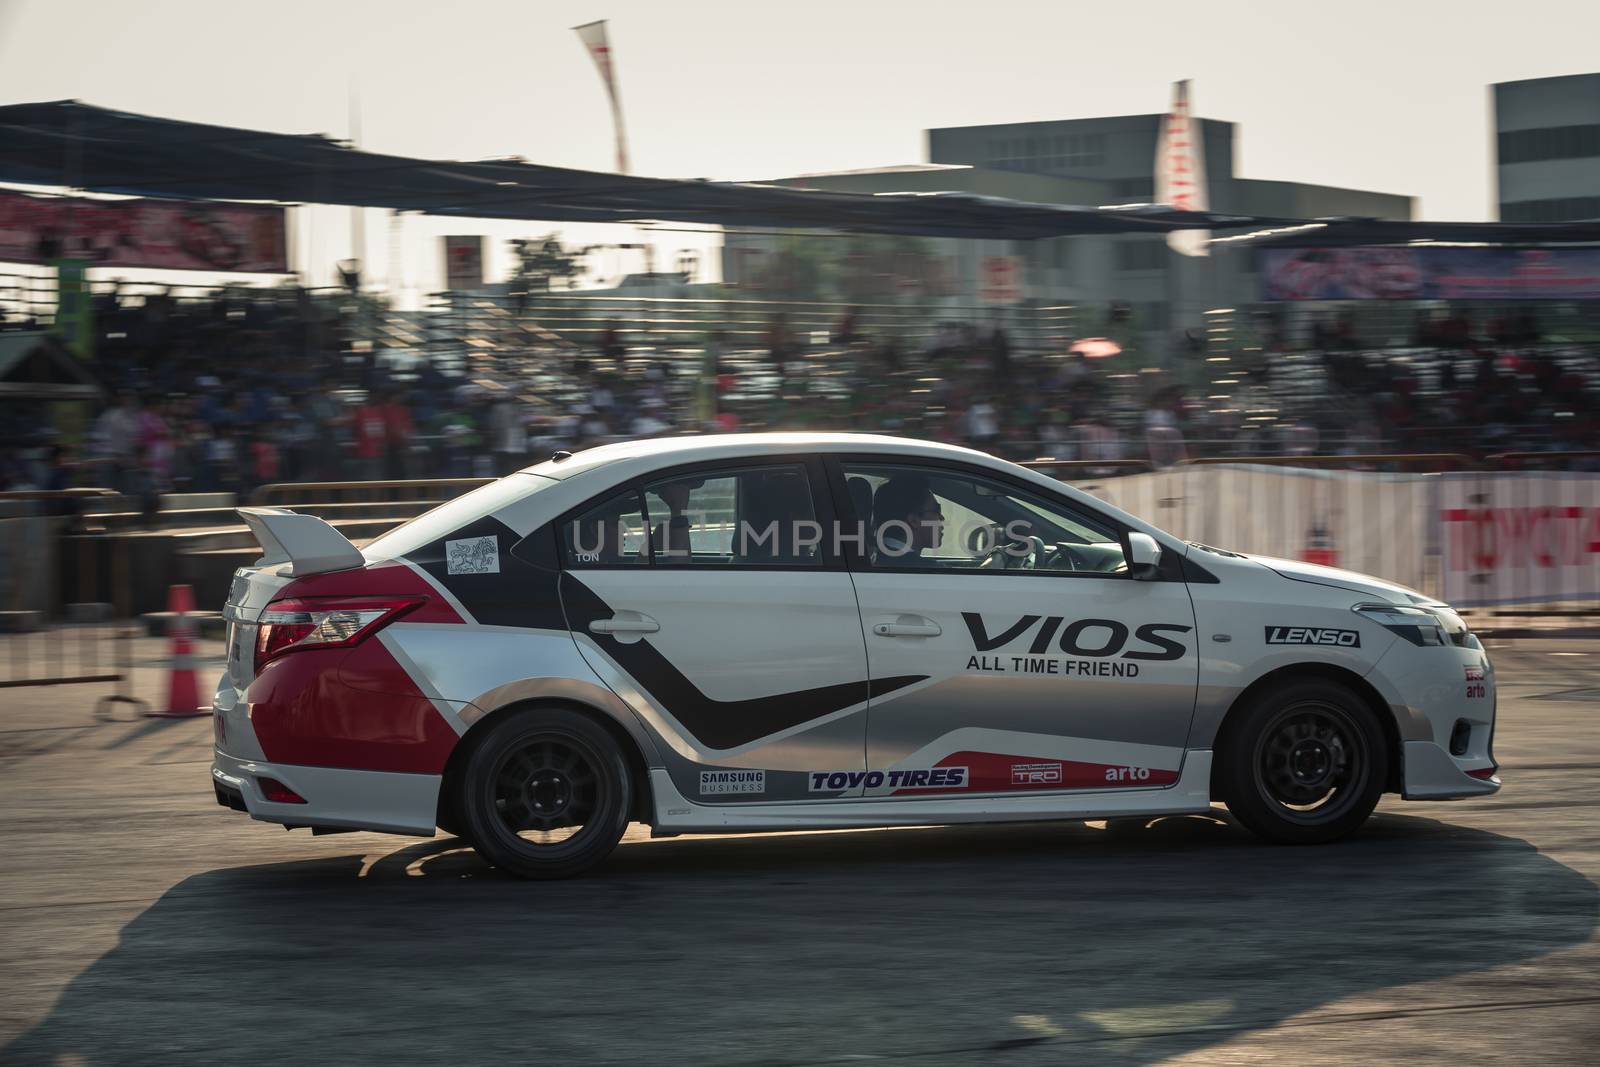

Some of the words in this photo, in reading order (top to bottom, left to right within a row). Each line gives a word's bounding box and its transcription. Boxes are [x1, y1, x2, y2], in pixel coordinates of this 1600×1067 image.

[576, 553, 600, 563] TON
[961, 612, 1193, 661] VIOS
[1268, 628, 1357, 646] LENSO
[966, 655, 1005, 671] ALL
[1012, 657, 1059, 674] TIME
[1066, 660, 1139, 678] FRIEND
[1466, 683, 1486, 698] arto
[702, 772, 763, 783] SAMSUNG
[812, 771, 885, 790] TOYO
[888, 768, 965, 787] TIRES
[1014, 771, 1059, 783] TRD
[1105, 766, 1150, 780] arto
[701, 783, 763, 793] BUSINESS
